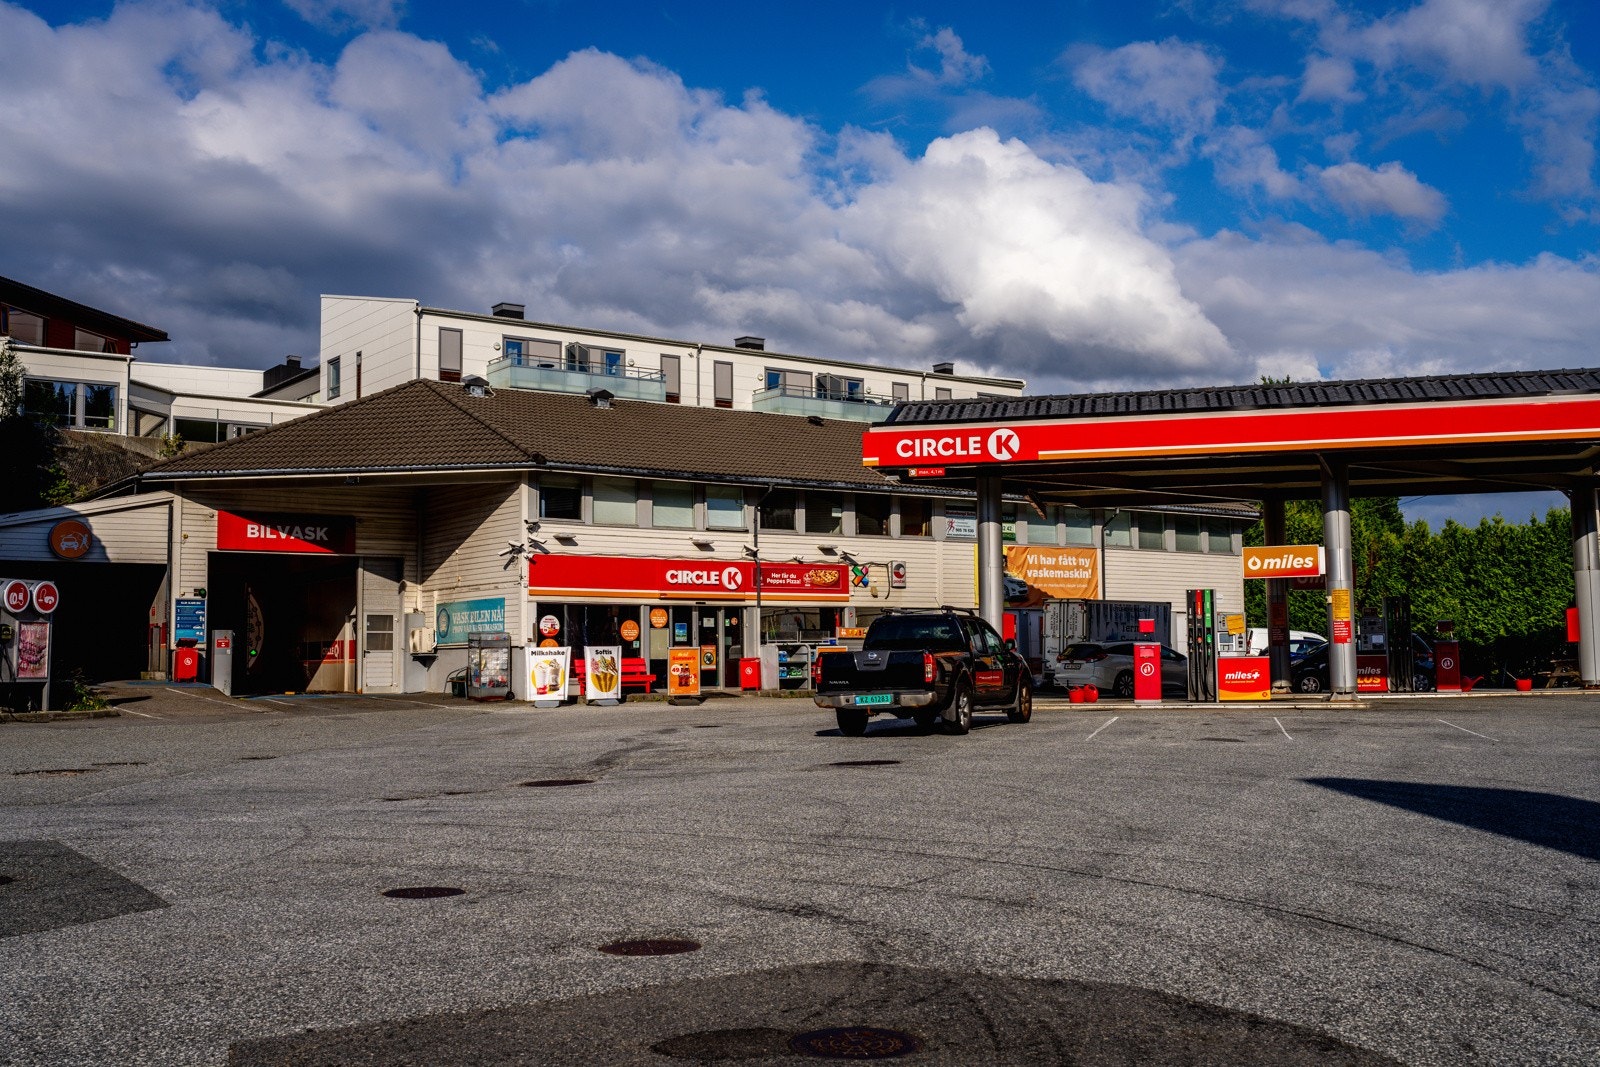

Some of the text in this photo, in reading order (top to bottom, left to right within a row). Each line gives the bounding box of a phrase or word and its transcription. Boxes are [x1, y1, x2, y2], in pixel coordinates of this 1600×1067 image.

[896, 431, 1019, 460] CIRCLE K
[247, 524, 328, 541] BILVASK
[1027, 554, 1091, 567] Vi har fått ny
[1262, 554, 1314, 569] miles
[665, 569, 741, 589] CIRCLE K
[1027, 568, 1091, 578] vaskemaskin!
[452, 605, 504, 624] VASK BILEN NÅ!
[1357, 666, 1382, 674] miles
[1357, 675, 1381, 683] LUS
